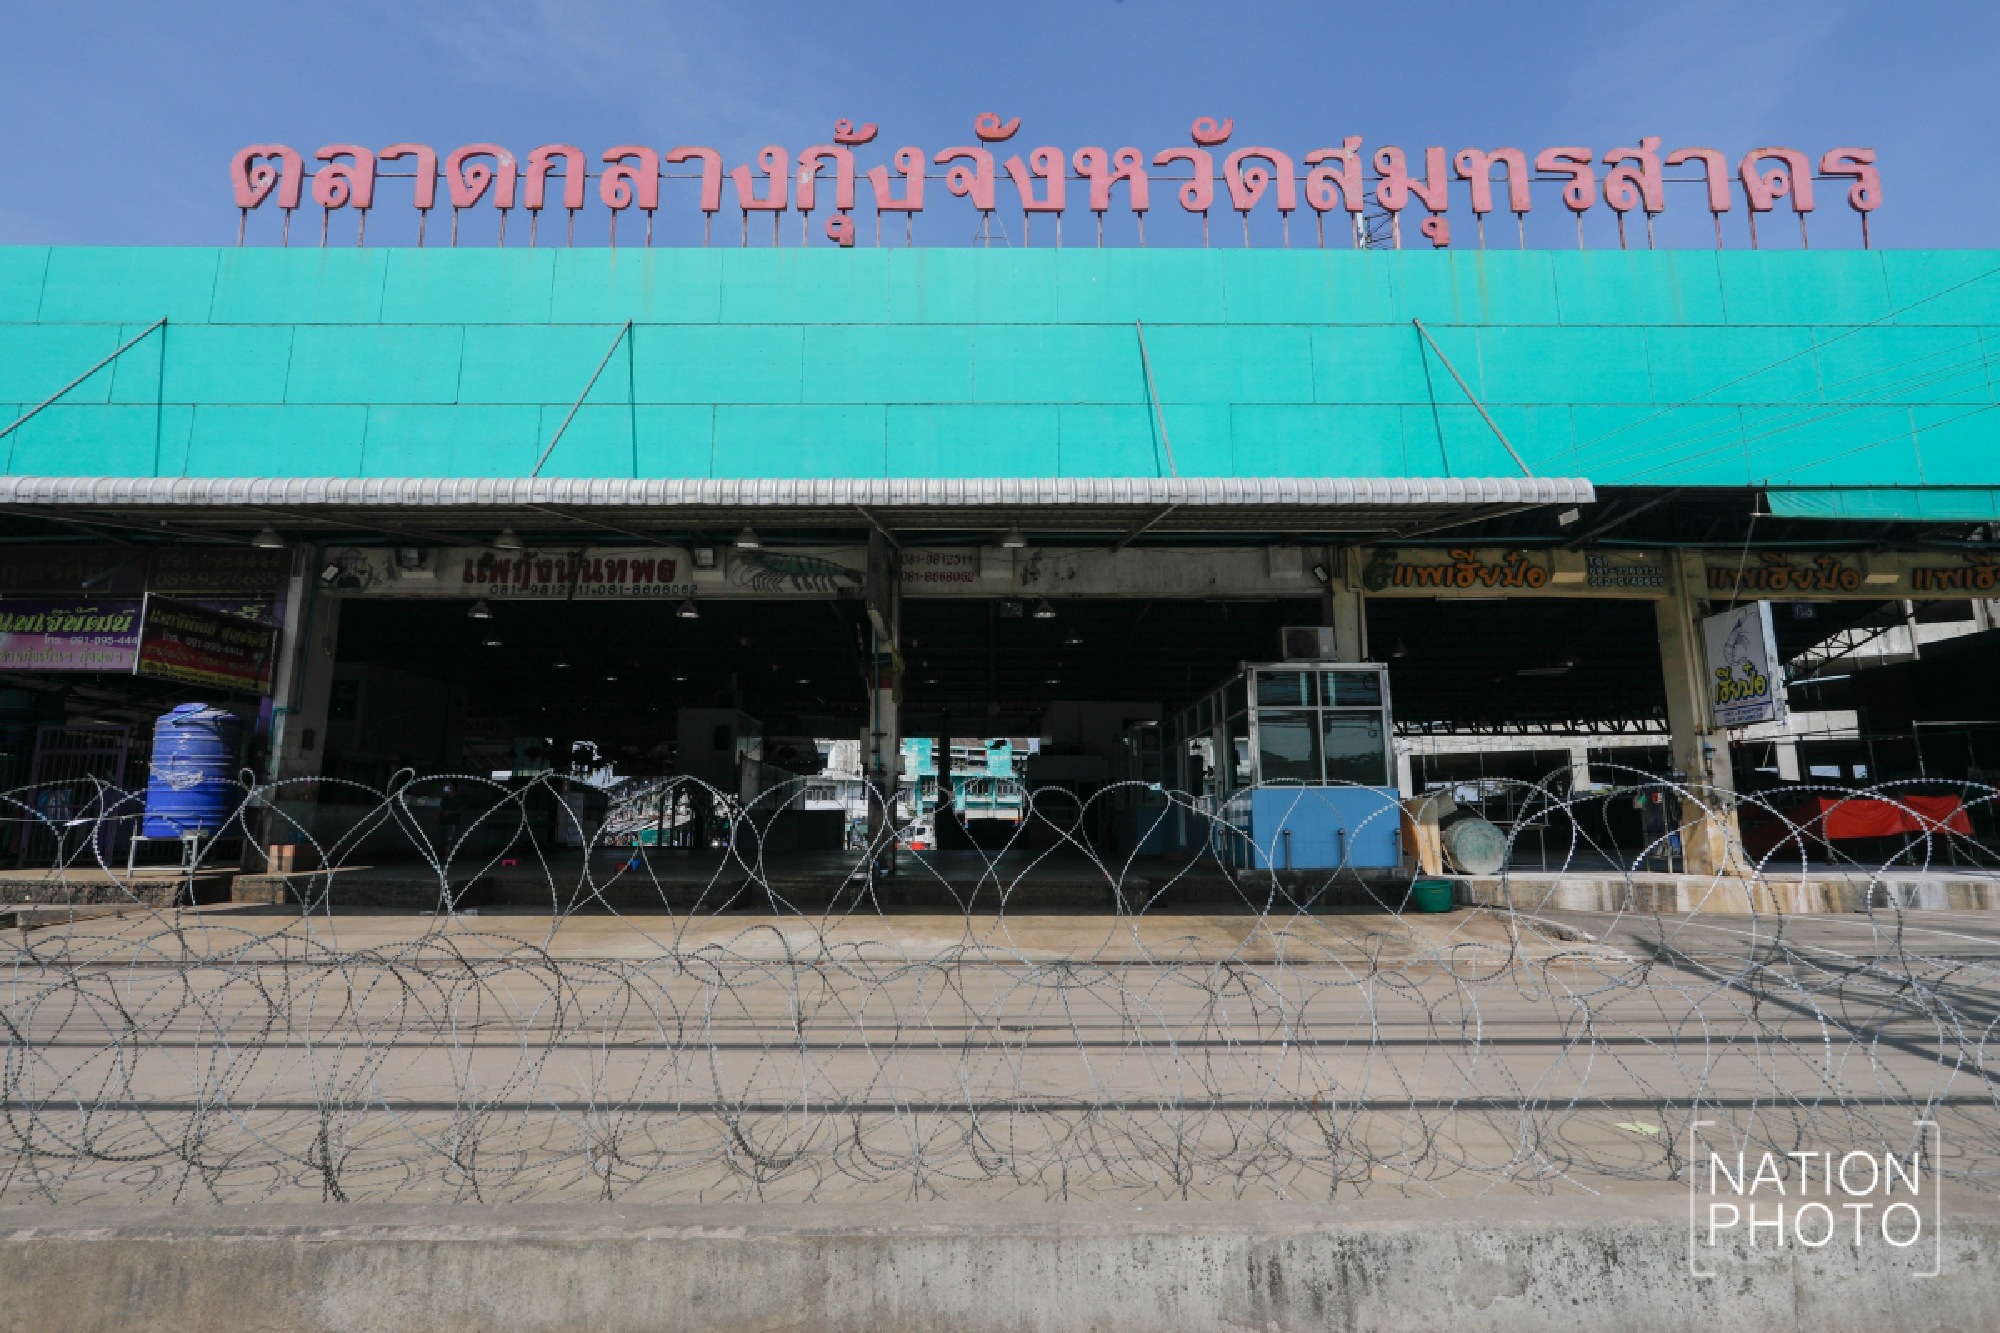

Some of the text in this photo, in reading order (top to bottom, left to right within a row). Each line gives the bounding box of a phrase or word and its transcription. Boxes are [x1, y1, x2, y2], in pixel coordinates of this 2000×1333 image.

[230, 112, 1880, 248] ตลาดกลางกุ้งจังหวัดสมุทรสาคร
